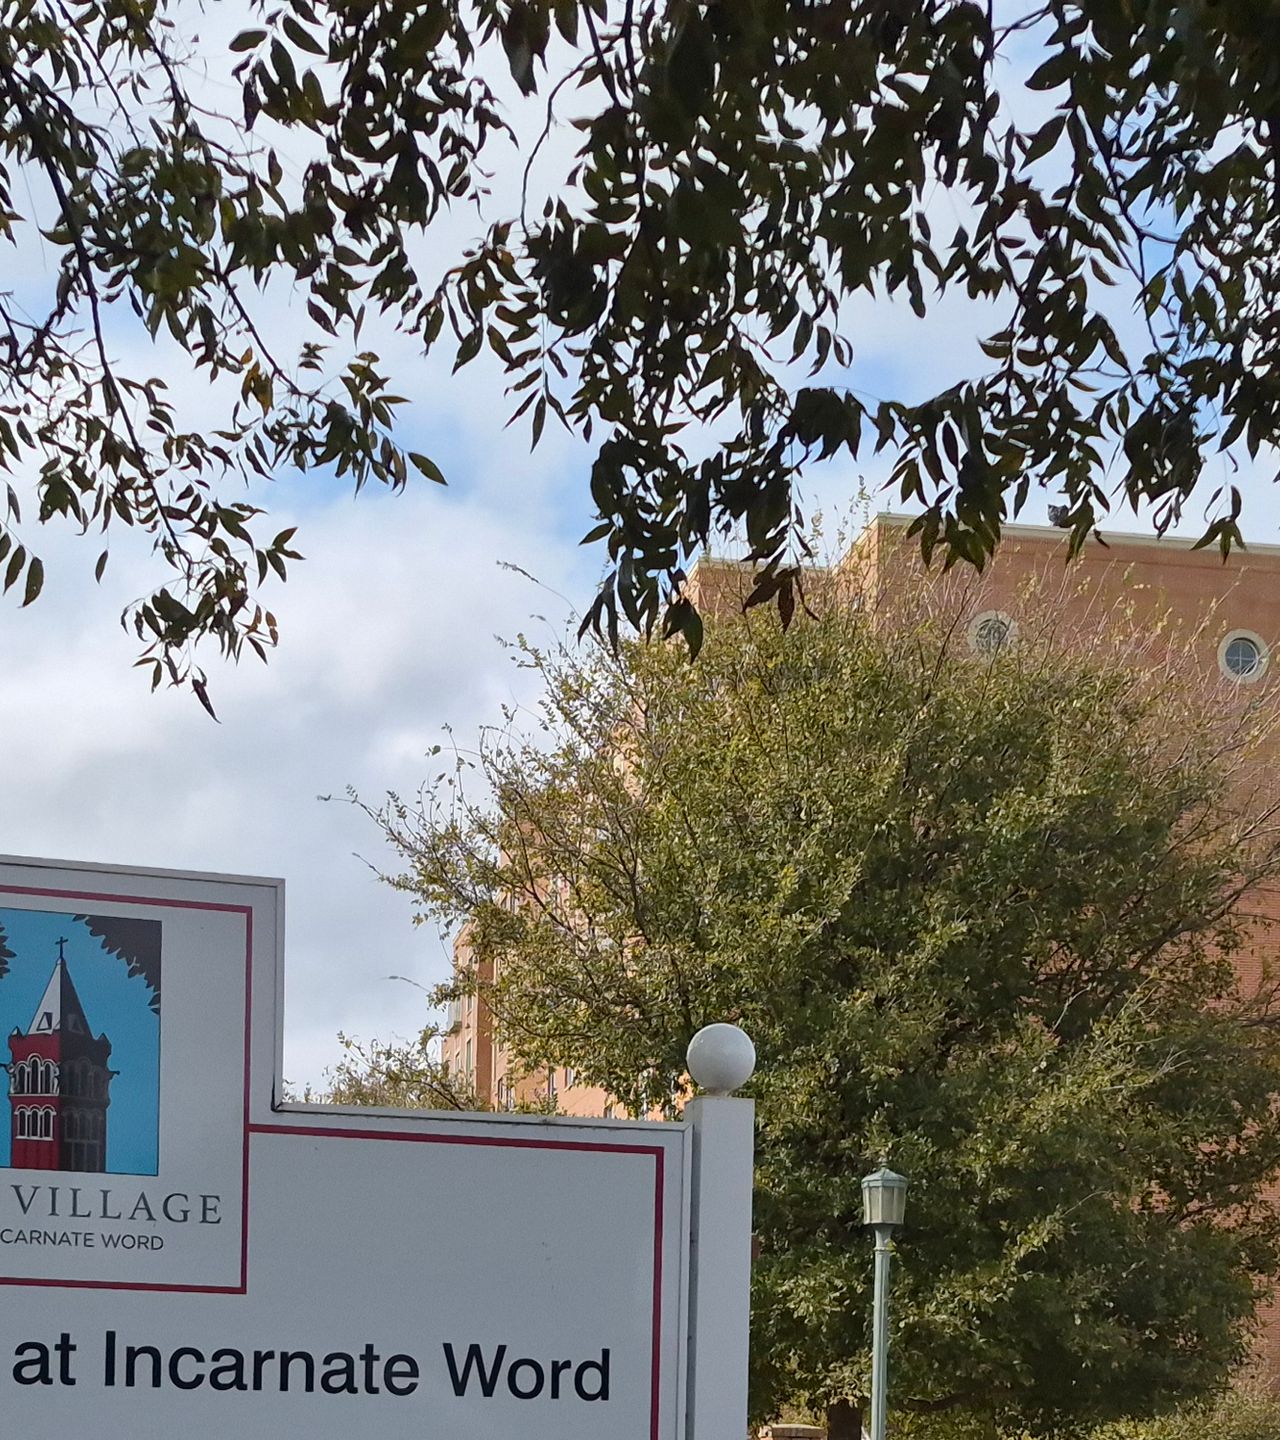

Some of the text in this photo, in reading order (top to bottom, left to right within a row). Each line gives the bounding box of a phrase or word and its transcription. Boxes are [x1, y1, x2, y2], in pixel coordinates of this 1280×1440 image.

[10, 1184, 222, 1225] VILLAGE
[100, 1233, 164, 1251] WORD
[12, 1332, 77, 1386] at
[104, 1330, 420, 1397] Incarnate
[442, 1342, 610, 1402] Word
